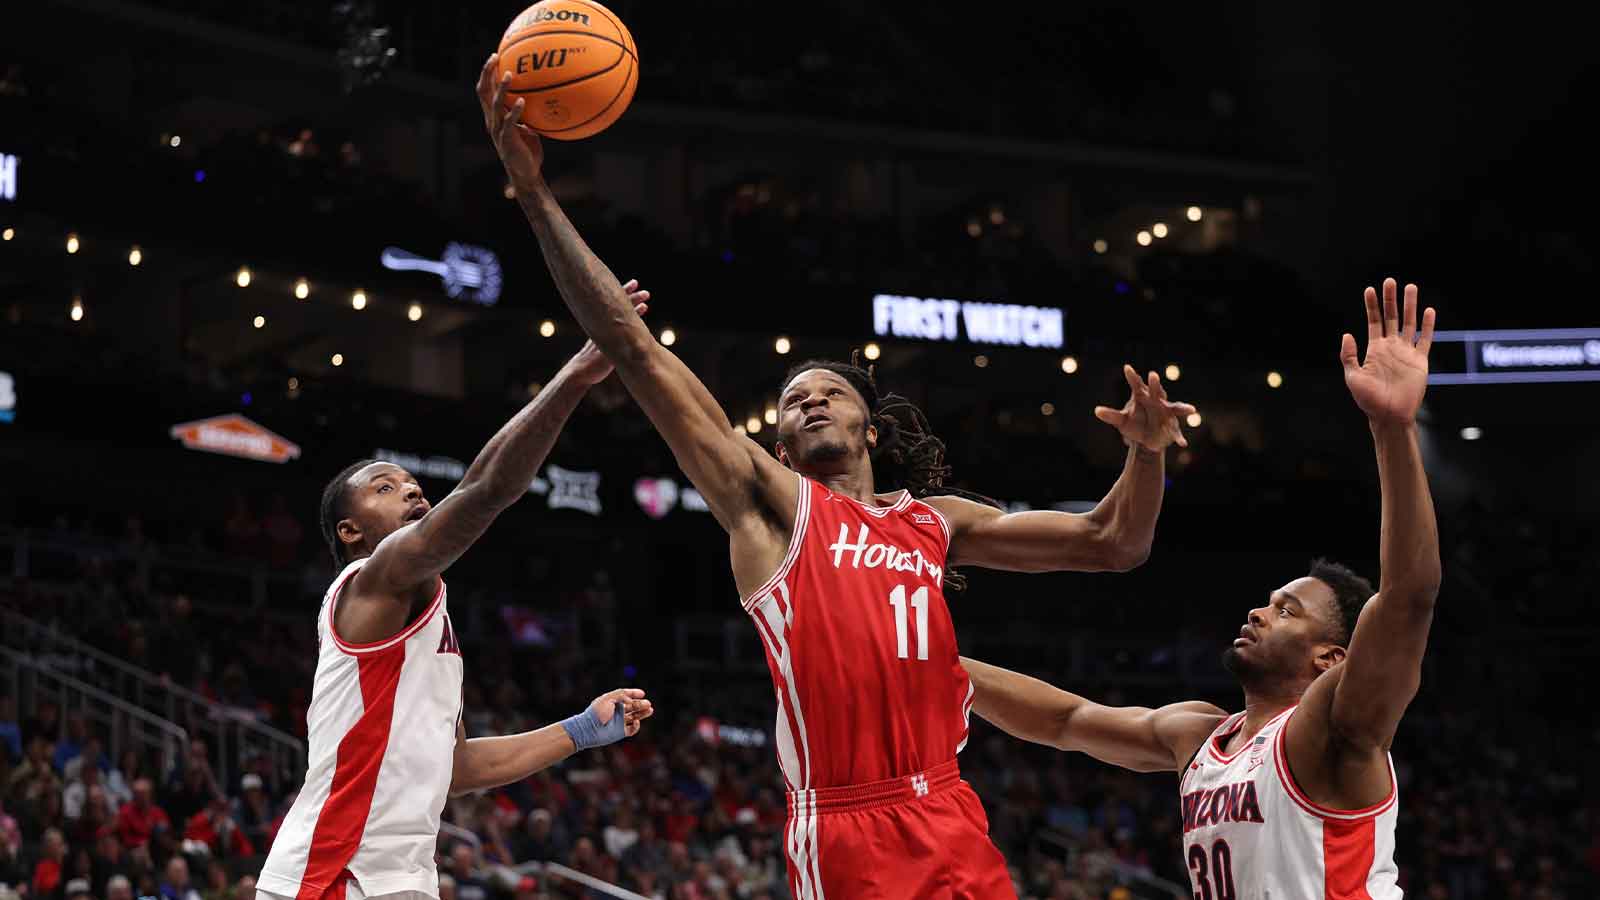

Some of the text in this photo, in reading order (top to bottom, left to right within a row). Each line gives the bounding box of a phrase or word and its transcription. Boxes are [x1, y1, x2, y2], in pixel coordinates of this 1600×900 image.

[524, 7, 590, 26] ilson
[516, 48, 567, 75] EVO
[873, 294, 1064, 348] FIRST WATCH
[889, 584, 929, 662] 11
[1183, 780, 1265, 833] RIZONA
[1189, 838, 1236, 900] 30
